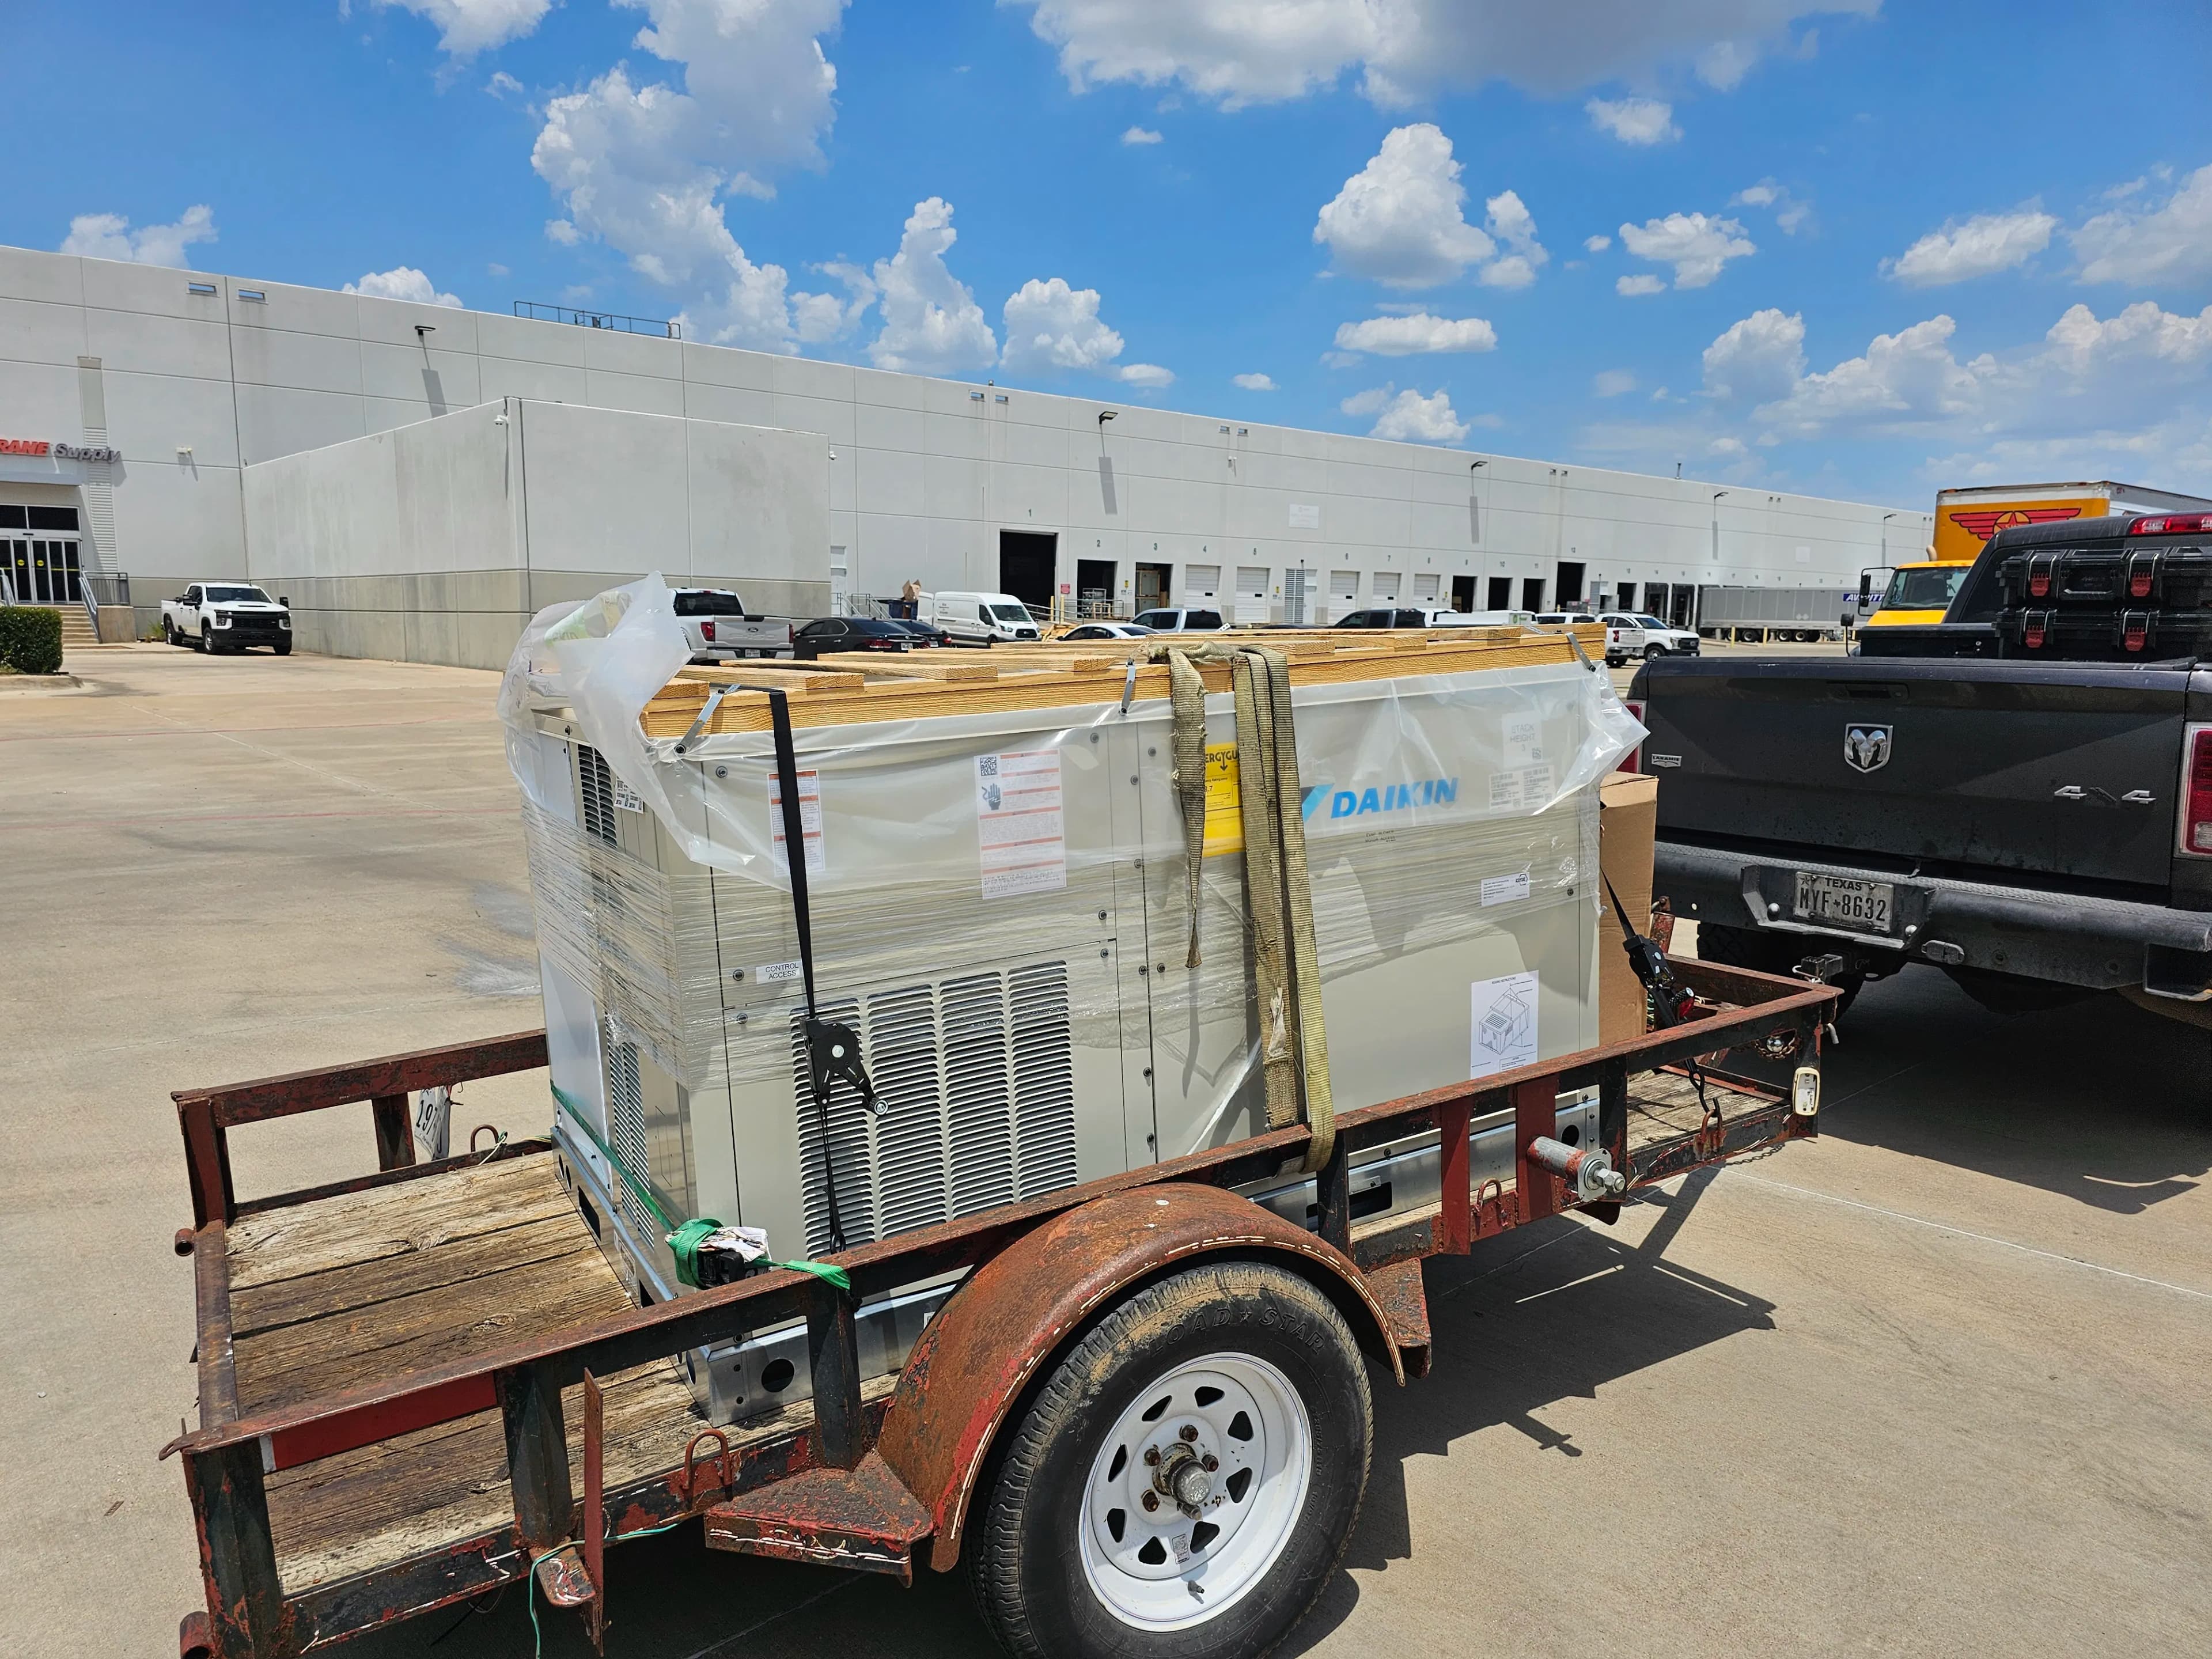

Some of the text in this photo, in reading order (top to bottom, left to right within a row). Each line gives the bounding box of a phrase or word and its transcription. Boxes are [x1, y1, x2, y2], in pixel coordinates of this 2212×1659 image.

[0, 440, 121, 463] RANE Supply
[1028, 509, 1032, 517] 1
[1153, 543, 1158, 551] 3
[1510, 733, 1536, 743] HEIGHT
[1205, 749, 1238, 764] ERGYGU
[1331, 778, 1459, 819] DAIKIN
[1825, 877, 1862, 891] TEXAS
[1842, 894, 1886, 922] 8632
[766, 963, 799, 973] CONTROL
[768, 970, 797, 979] ACCESS
[1150, 1307, 1325, 1354] LOAD STAR
